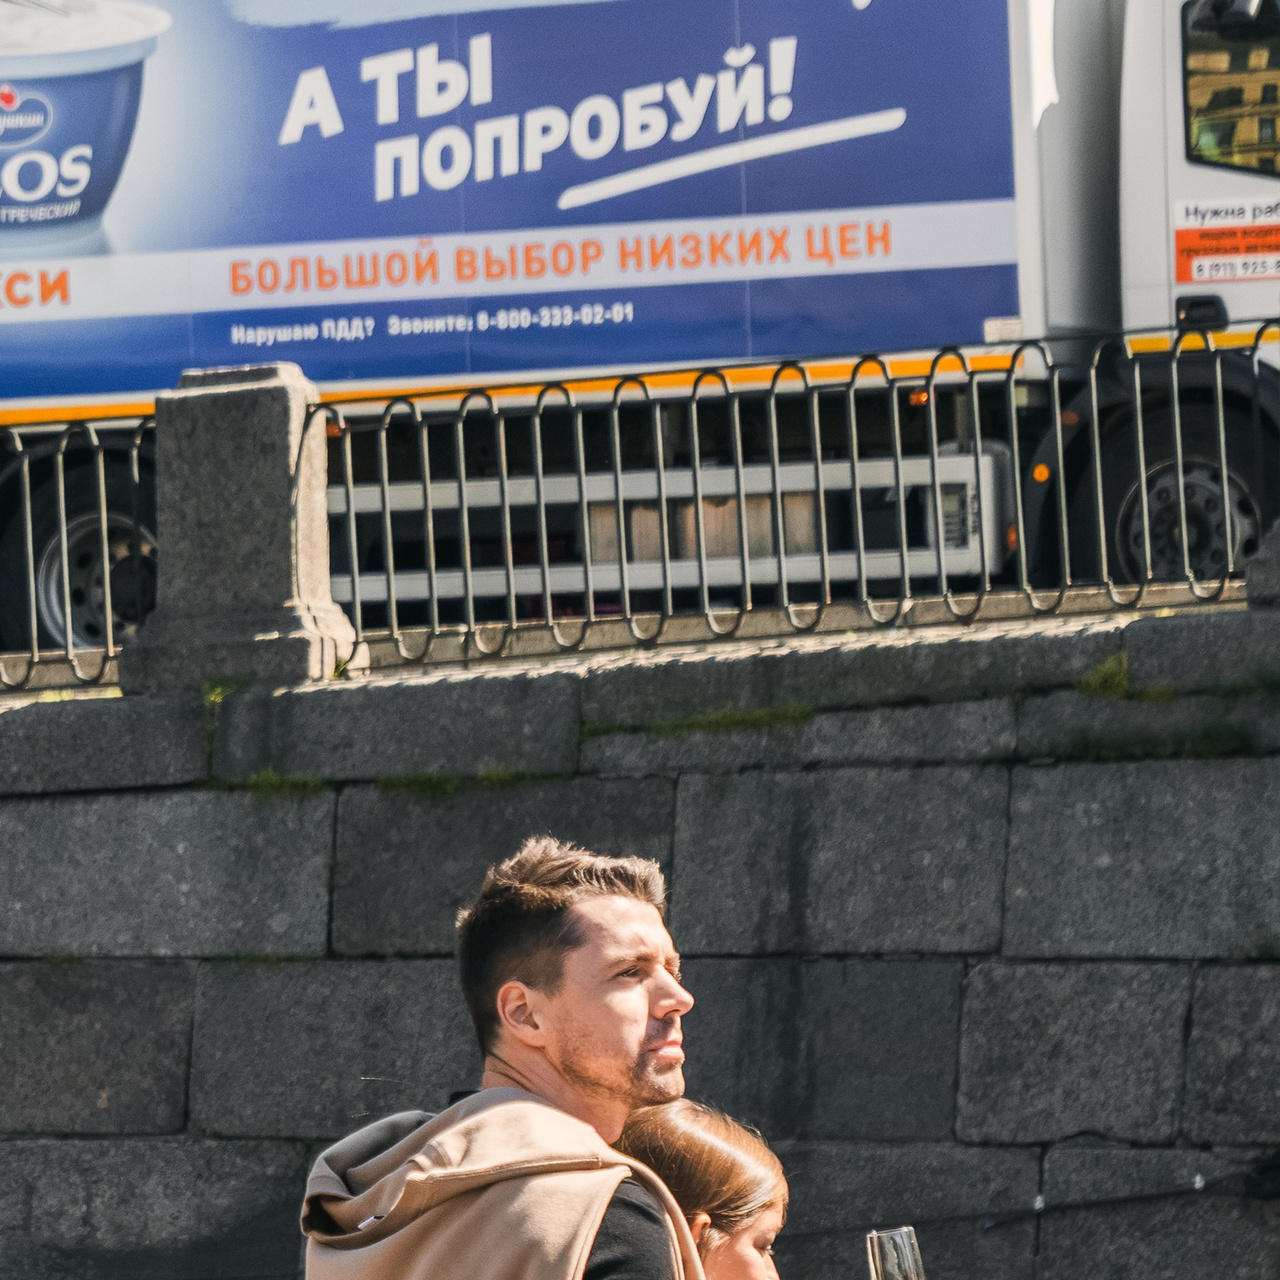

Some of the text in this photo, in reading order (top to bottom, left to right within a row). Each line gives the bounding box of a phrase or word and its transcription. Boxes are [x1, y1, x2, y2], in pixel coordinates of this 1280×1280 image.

[278, 33, 493, 146] А ТЫ
[374, 36, 798, 203] ПОПРОБУЙ!
[1185, 204, 1246, 226] Нужна
[230, 221, 893, 295] БОЛЬШОЙ ВЫБОР НИЗКИХ ЦЕН
[231, 301, 635, 347] Нарушаю ПДД? Звоните: 8-800-333-02-01
